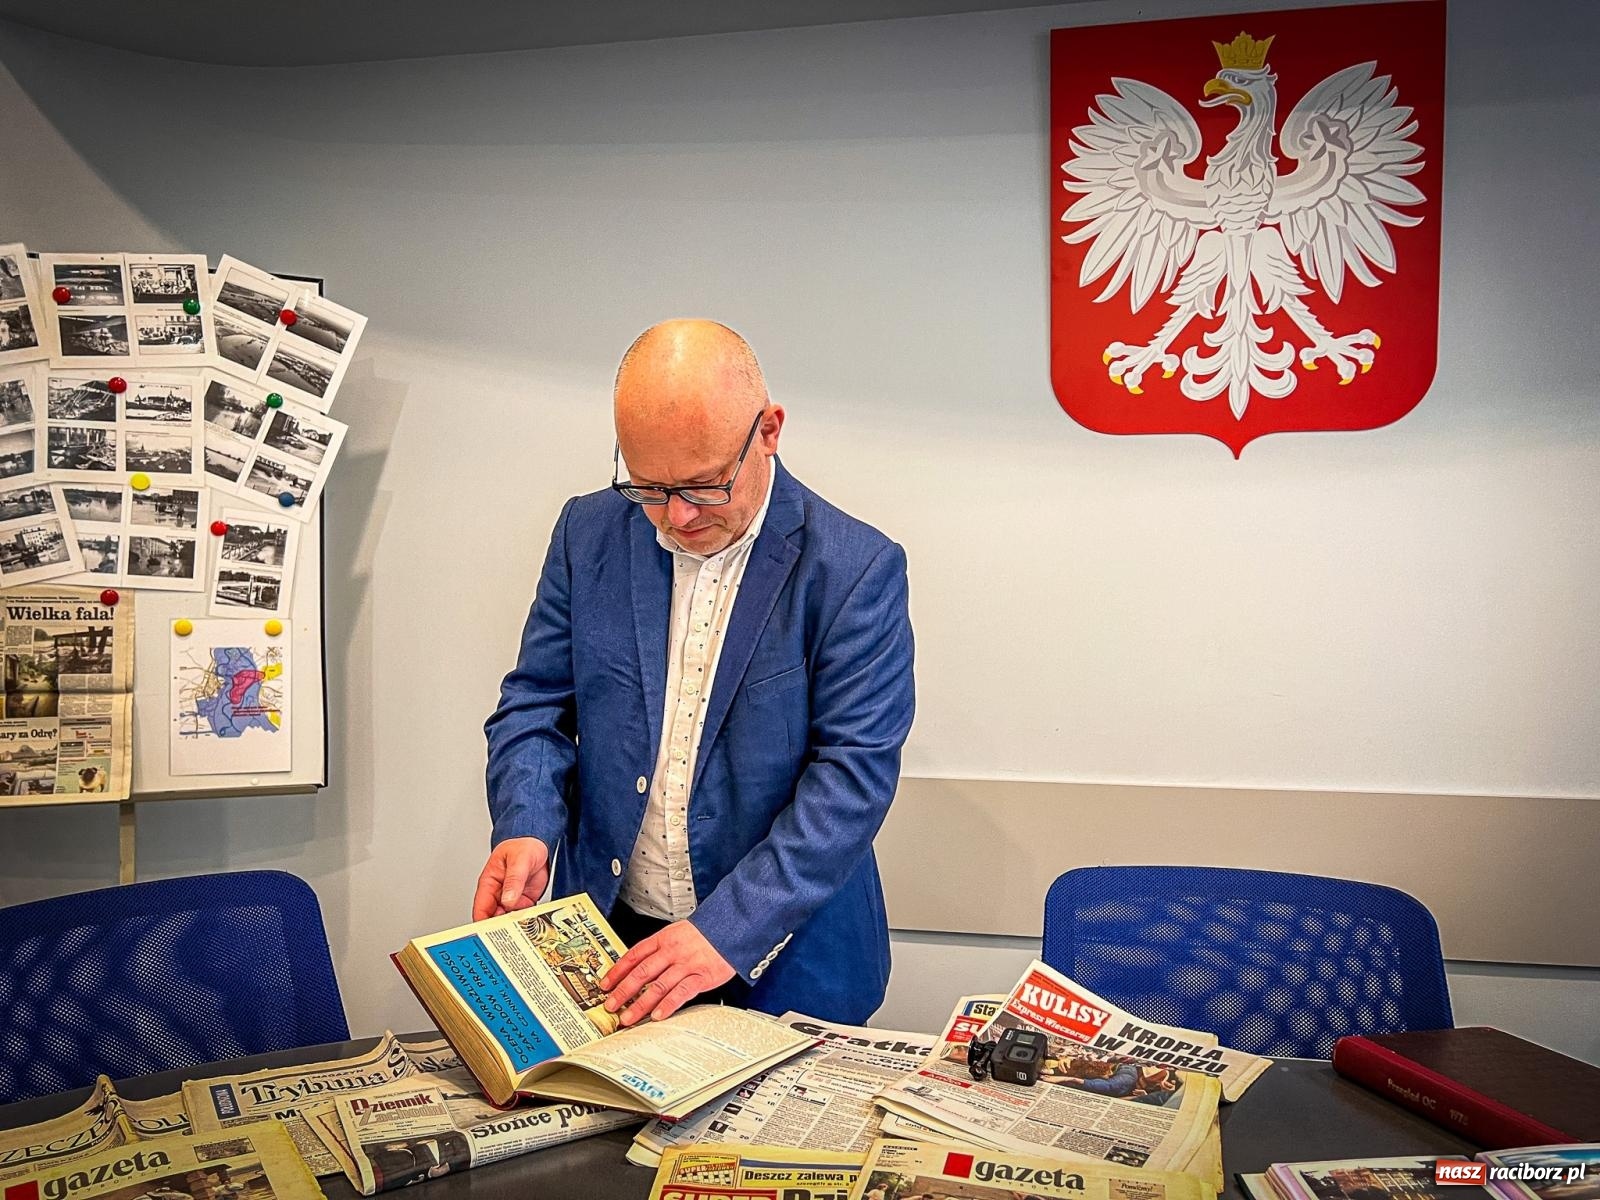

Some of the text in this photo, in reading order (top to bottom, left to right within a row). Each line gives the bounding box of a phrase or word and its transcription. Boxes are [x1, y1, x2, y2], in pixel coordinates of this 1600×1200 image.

[6, 606, 115, 620] Wielka fala!
[0, 731, 16, 740] ary
[31, 728, 57, 739] Odrę?
[457, 955, 486, 988] PRACY
[500, 990, 529, 1027] CZYNNIKI
[974, 1003, 999, 1016] Sta
[1019, 982, 1110, 1027] KULISY
[1011, 999, 1092, 1043] Express Wieczorny
[500, 1026, 529, 1064] OCENA
[531, 1031, 541, 1043] NA
[1118, 1022, 1225, 1061] KROPLA
[1093, 1033, 1228, 1074] W MORZU
[241, 1069, 389, 1105] Trybuna
[350, 1093, 433, 1115] Dziennik
[359, 1102, 448, 1126] Zachodni
[470, 1110, 552, 1139] Słońce
[43, 1151, 171, 1200] gazeta
[744, 1170, 858, 1183] Deszcz zalewa p
[975, 1161, 1085, 1190] gazeta
